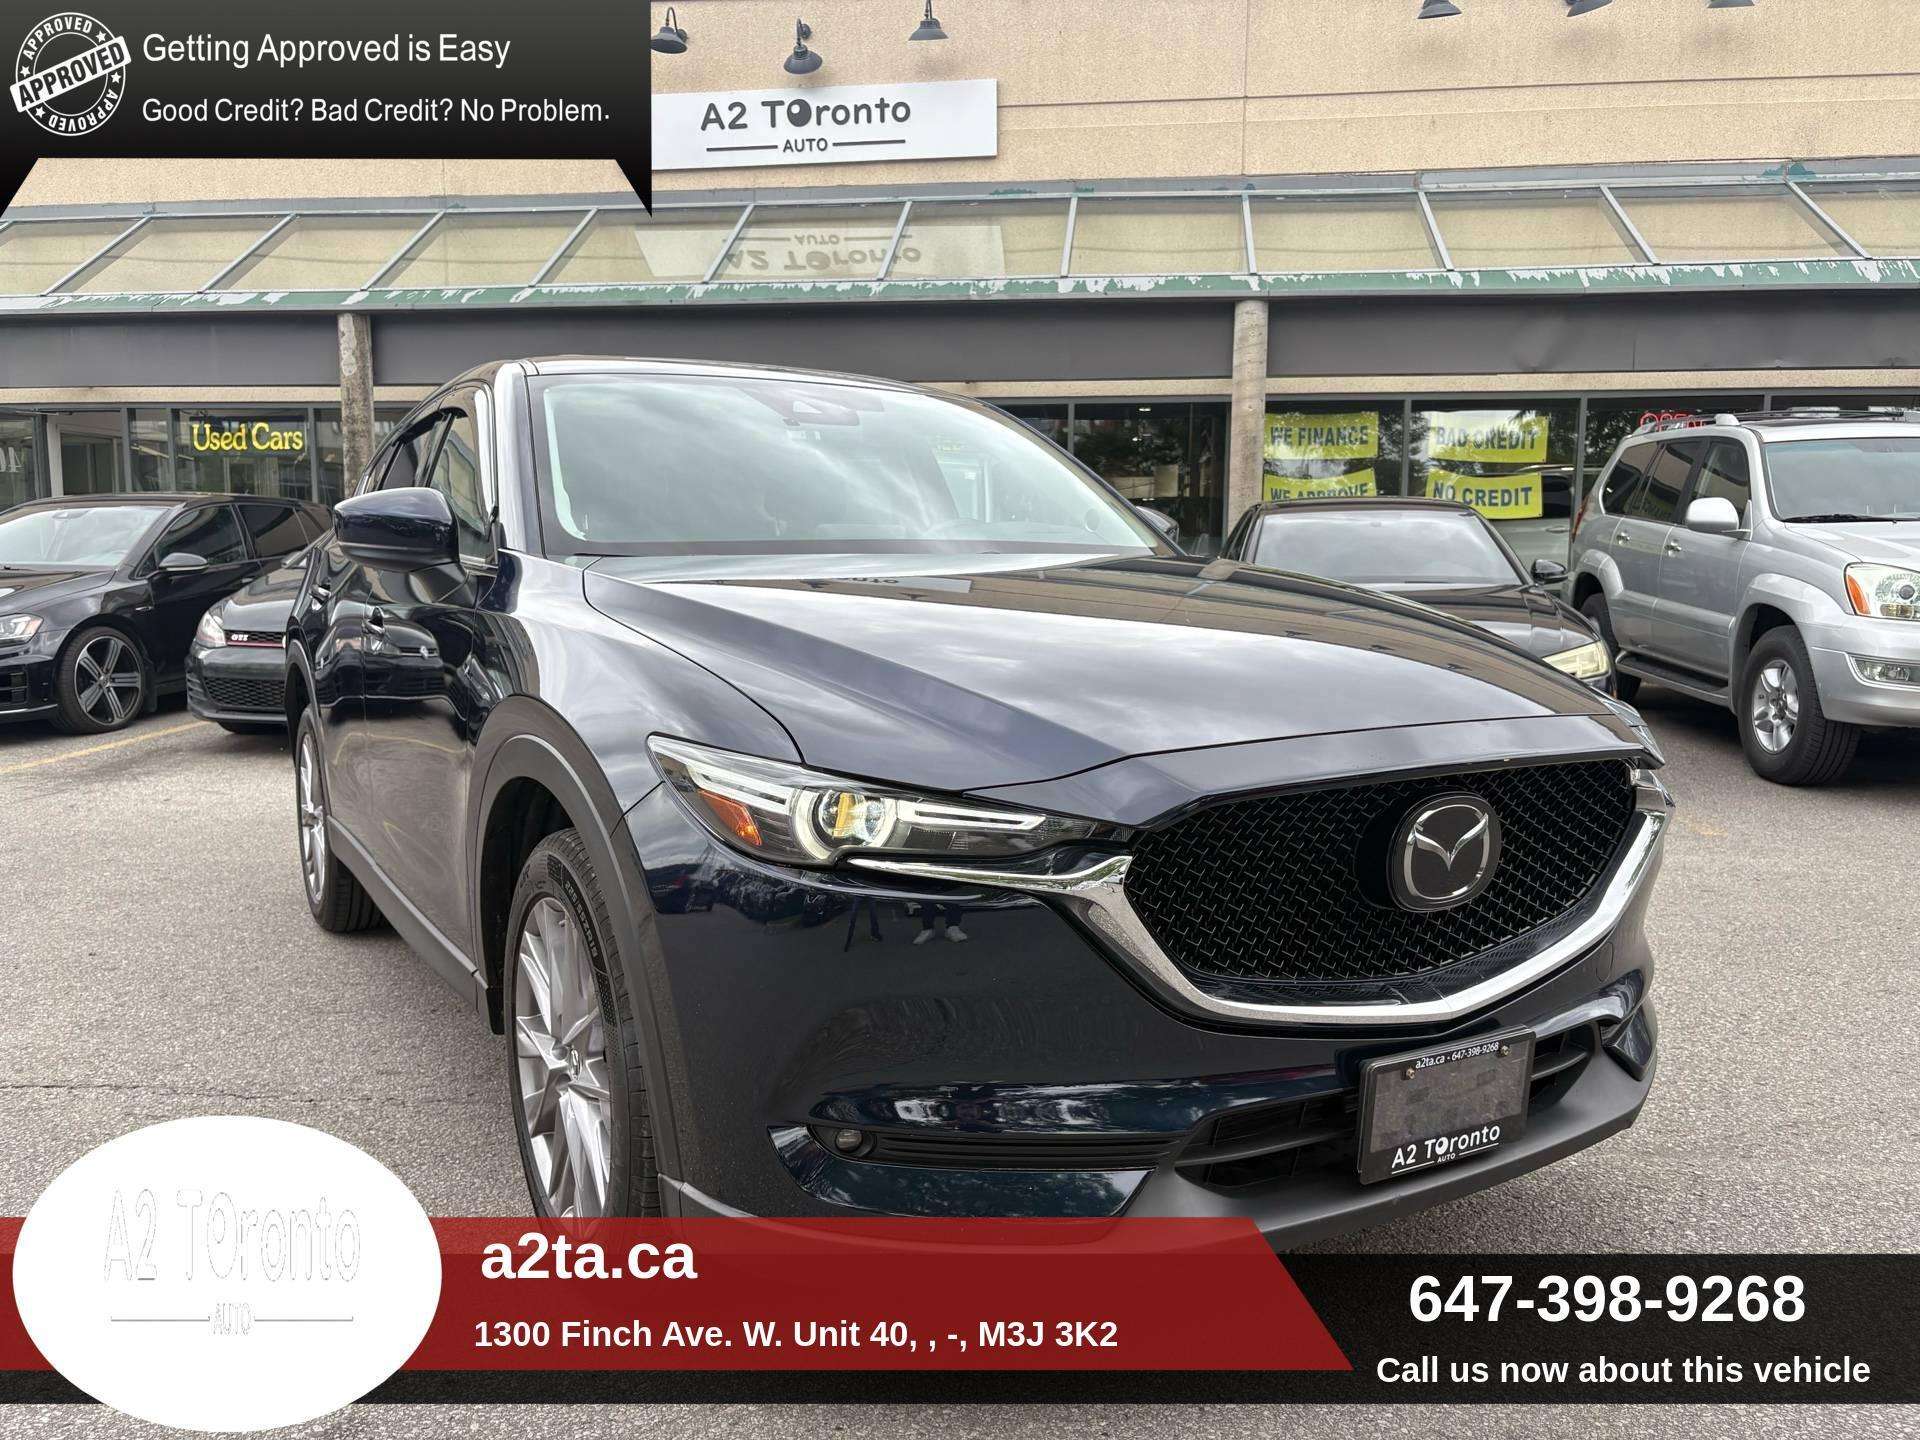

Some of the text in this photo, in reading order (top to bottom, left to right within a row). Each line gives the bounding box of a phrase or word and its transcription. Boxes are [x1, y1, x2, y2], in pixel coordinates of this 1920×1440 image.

[700, 100, 749, 131] A2
[782, 137, 829, 153] AUTO
[192, 422, 304, 451] Used Cars
[1270, 425, 1369, 446] WE FINANCE
[1436, 426, 1538, 450] BAD CREDIT
[1433, 482, 1533, 507] NO CREDIT
[231, 633, 249, 642] GTI
[1415, 1055, 1445, 1069] a2ta.ca
[1451, 1041, 1500, 1062] 647-398-9268
[1391, 1143, 1417, 1168] A2
[1437, 1152, 1456, 1163] AUTO
